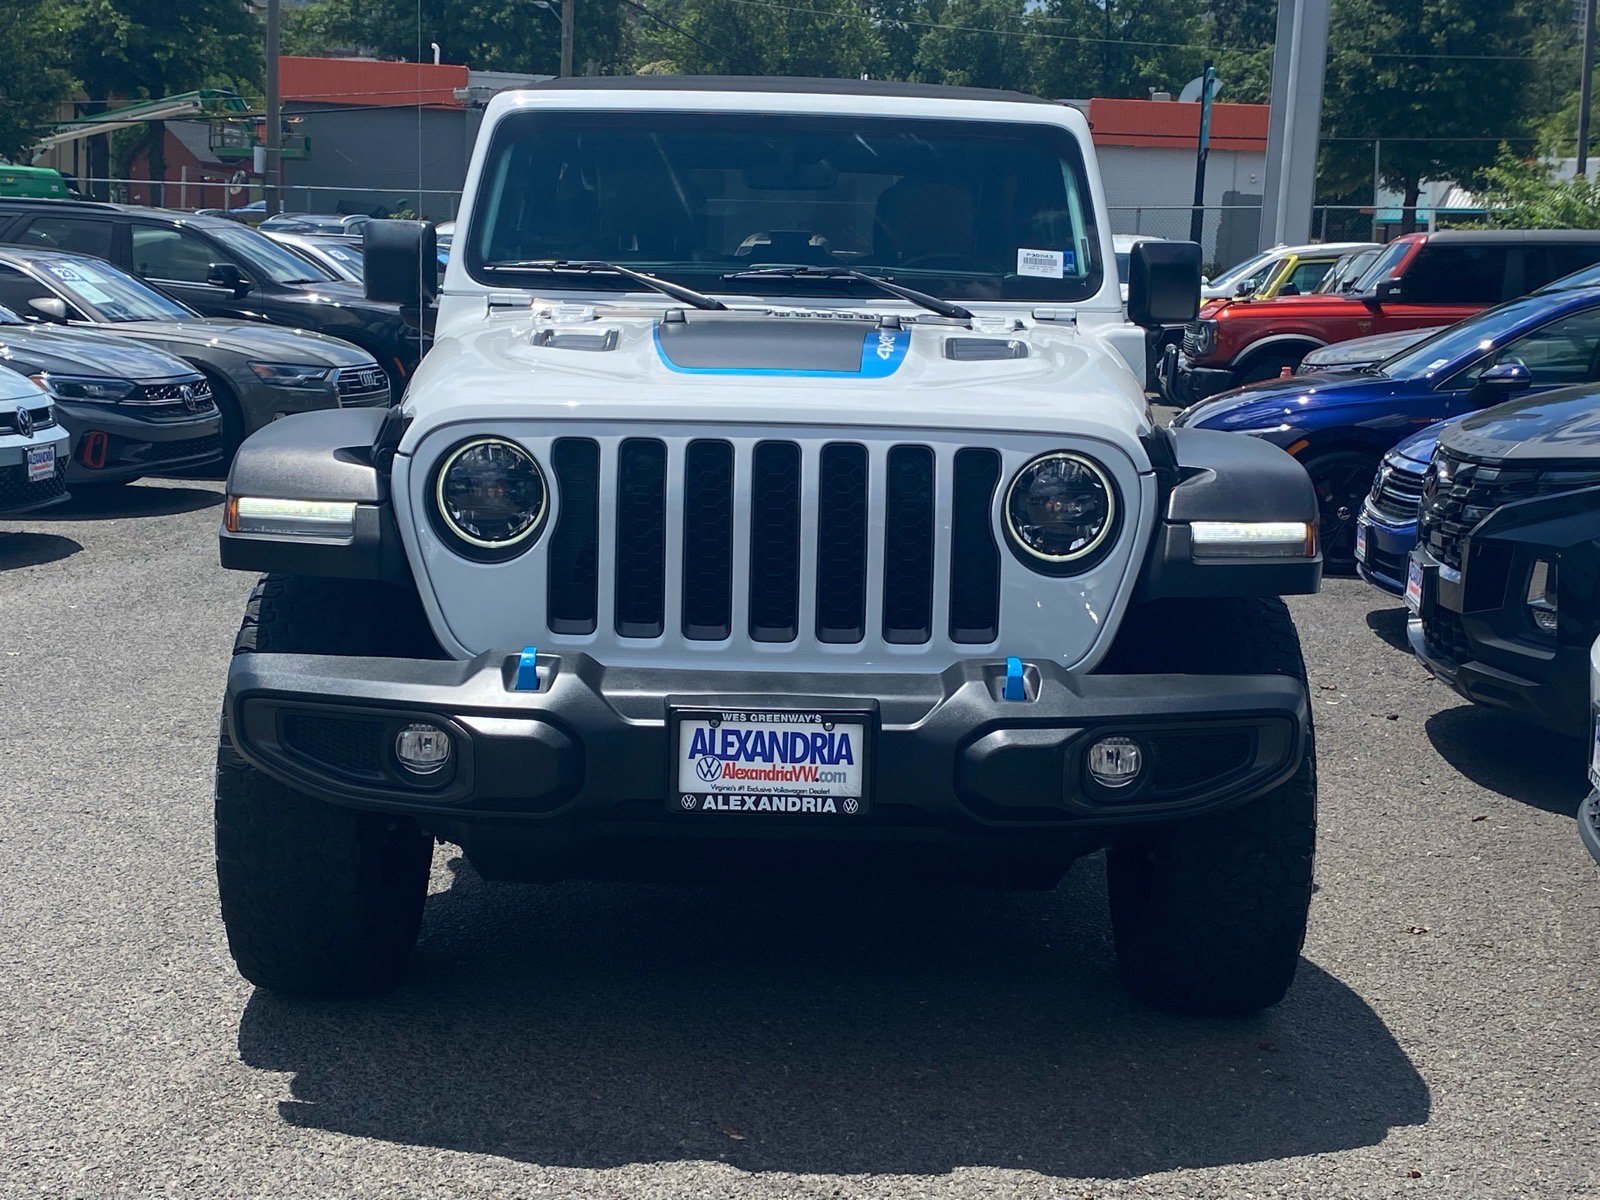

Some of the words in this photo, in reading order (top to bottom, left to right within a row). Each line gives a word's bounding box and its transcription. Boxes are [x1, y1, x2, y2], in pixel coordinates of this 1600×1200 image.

[722, 713, 747, 722] WES
[750, 713, 822, 723] GREENWAY'S
[688, 727, 854, 766] ALEXANDRIA
[721, 762, 847, 784] AlexandriaVW.com
[710, 783, 737, 793] Virginia's
[746, 786, 772, 794] Exclusive
[772, 786, 808, 796] Volkswagen
[702, 795, 837, 813] ALEXANDRIA
